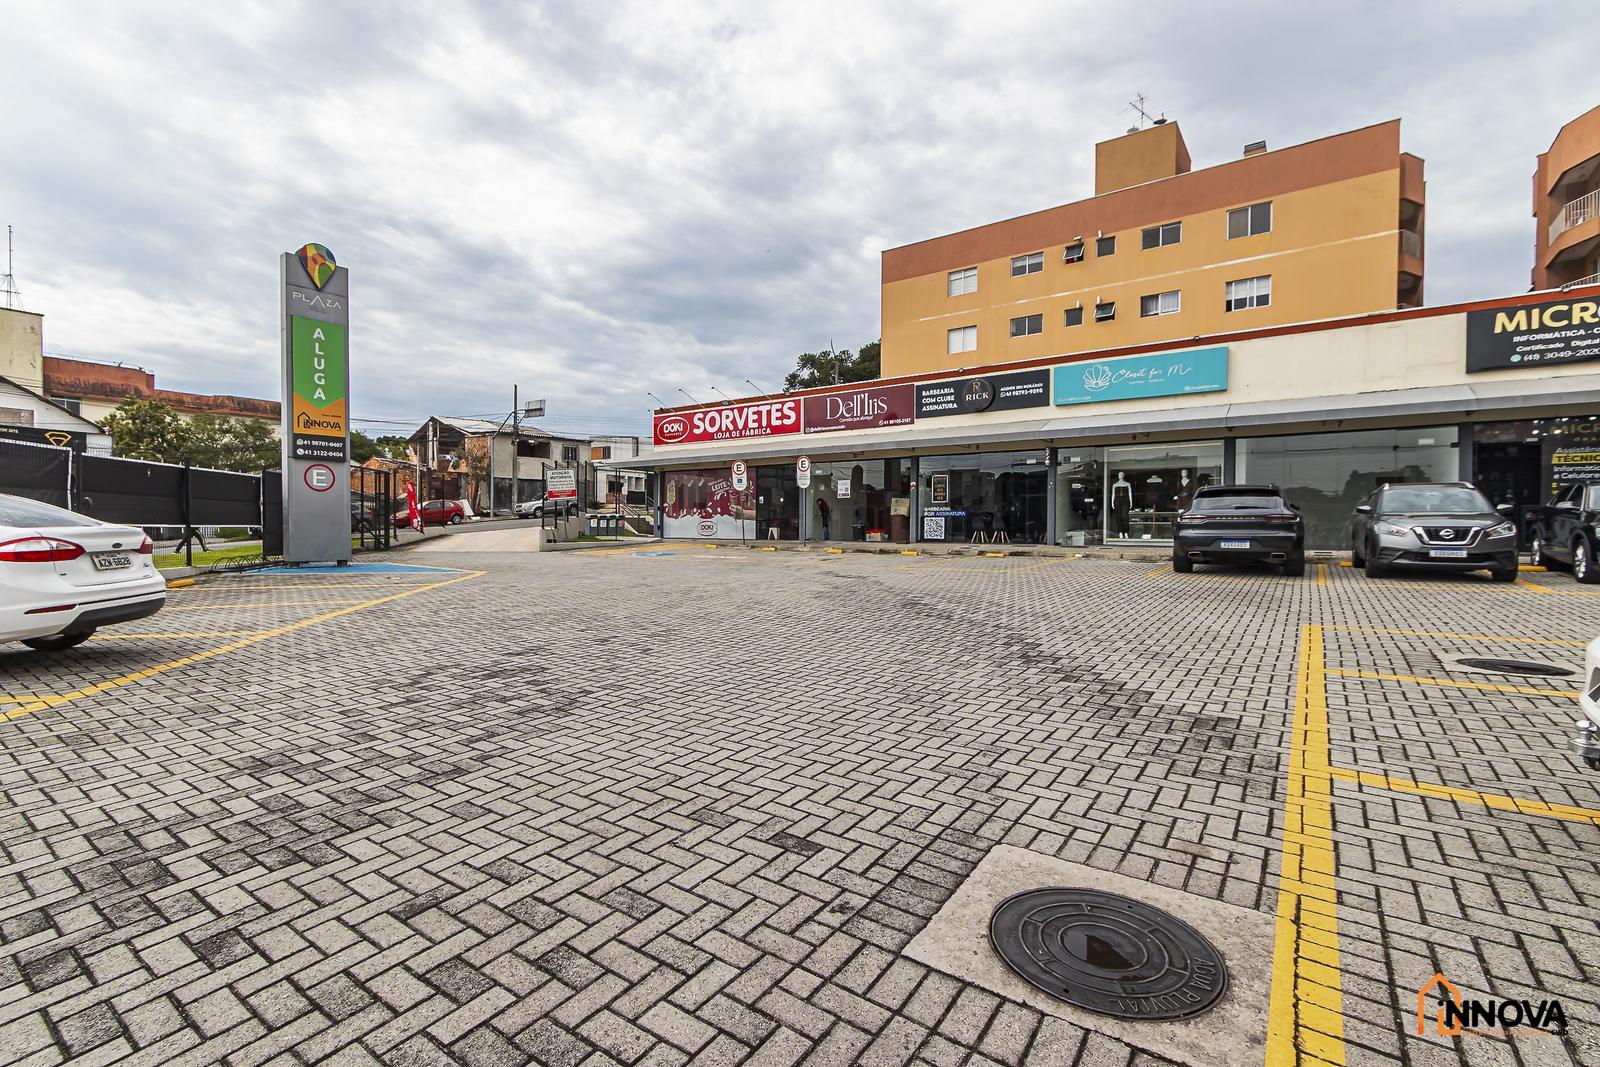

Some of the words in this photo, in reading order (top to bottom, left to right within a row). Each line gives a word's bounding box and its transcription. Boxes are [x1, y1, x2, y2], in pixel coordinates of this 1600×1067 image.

[292, 291, 342, 310] PLAZA
[313, 327, 326, 400] ALUGA
[922, 387, 954, 396] BARBEARIA
[937, 395, 955, 403] CLUBE
[966, 392, 989, 401] RICK
[922, 403, 957, 412] ASSINATURA
[693, 401, 796, 435] SORVETES
[663, 423, 683, 433] DOKI
[742, 427, 771, 436] FÁBRICA
[736, 464, 742, 472] E
[800, 460, 806, 469] E
[312, 469, 327, 486] E
